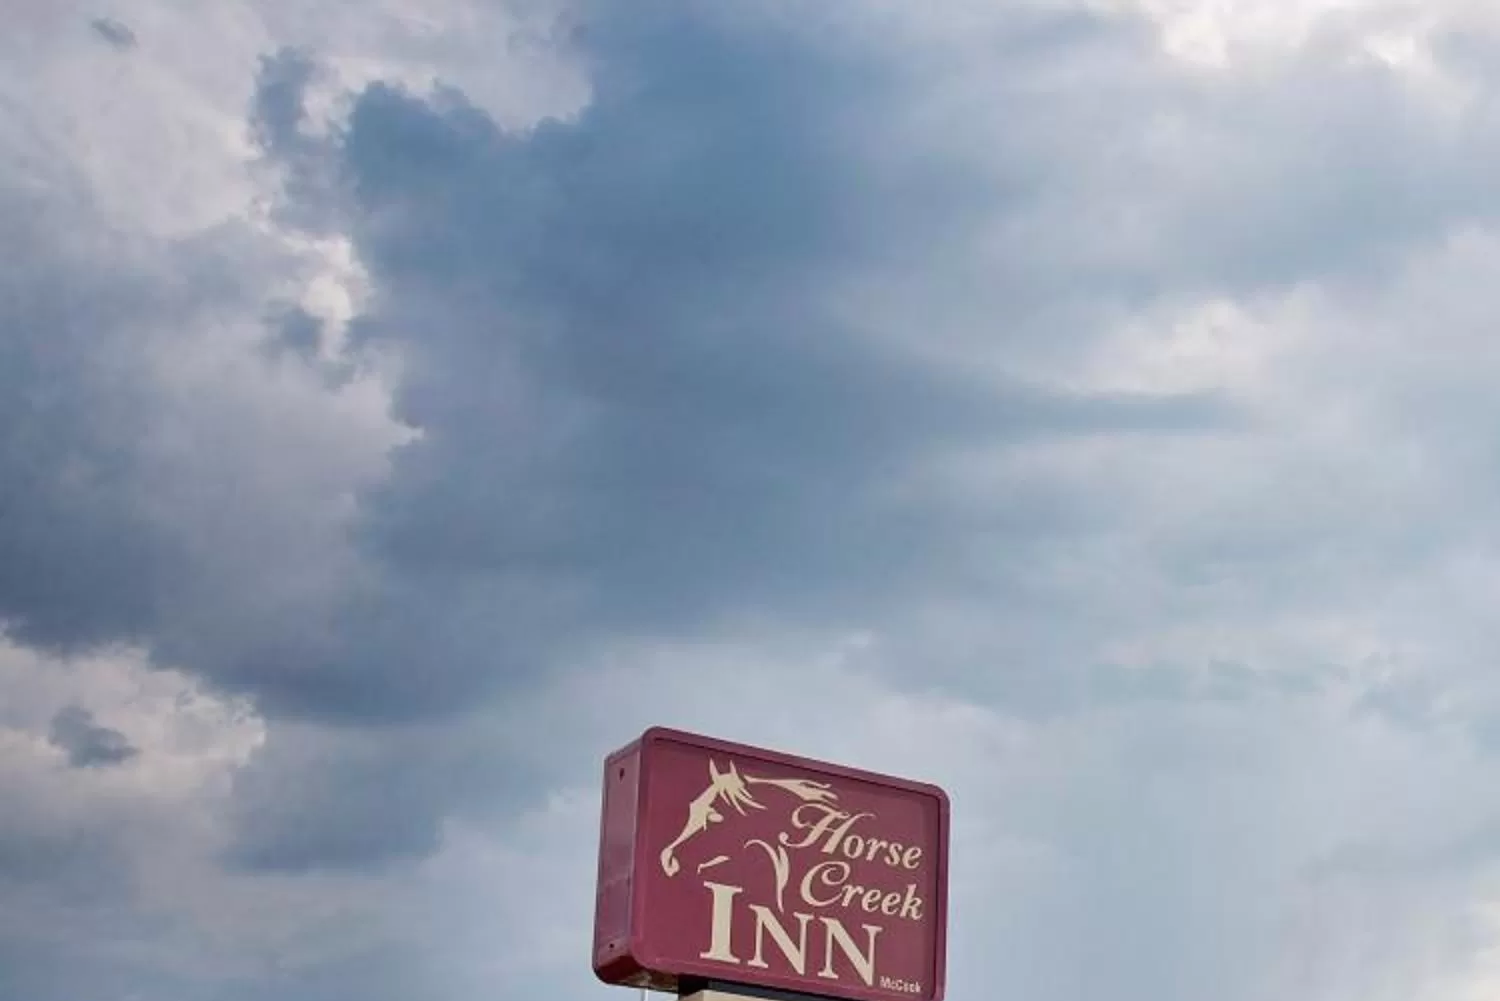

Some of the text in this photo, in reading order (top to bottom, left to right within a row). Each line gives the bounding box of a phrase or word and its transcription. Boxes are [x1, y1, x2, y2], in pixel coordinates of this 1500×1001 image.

[778, 803, 922, 869] Horse
[801, 861, 923, 920] Creek
[700, 881, 882, 986] INN
